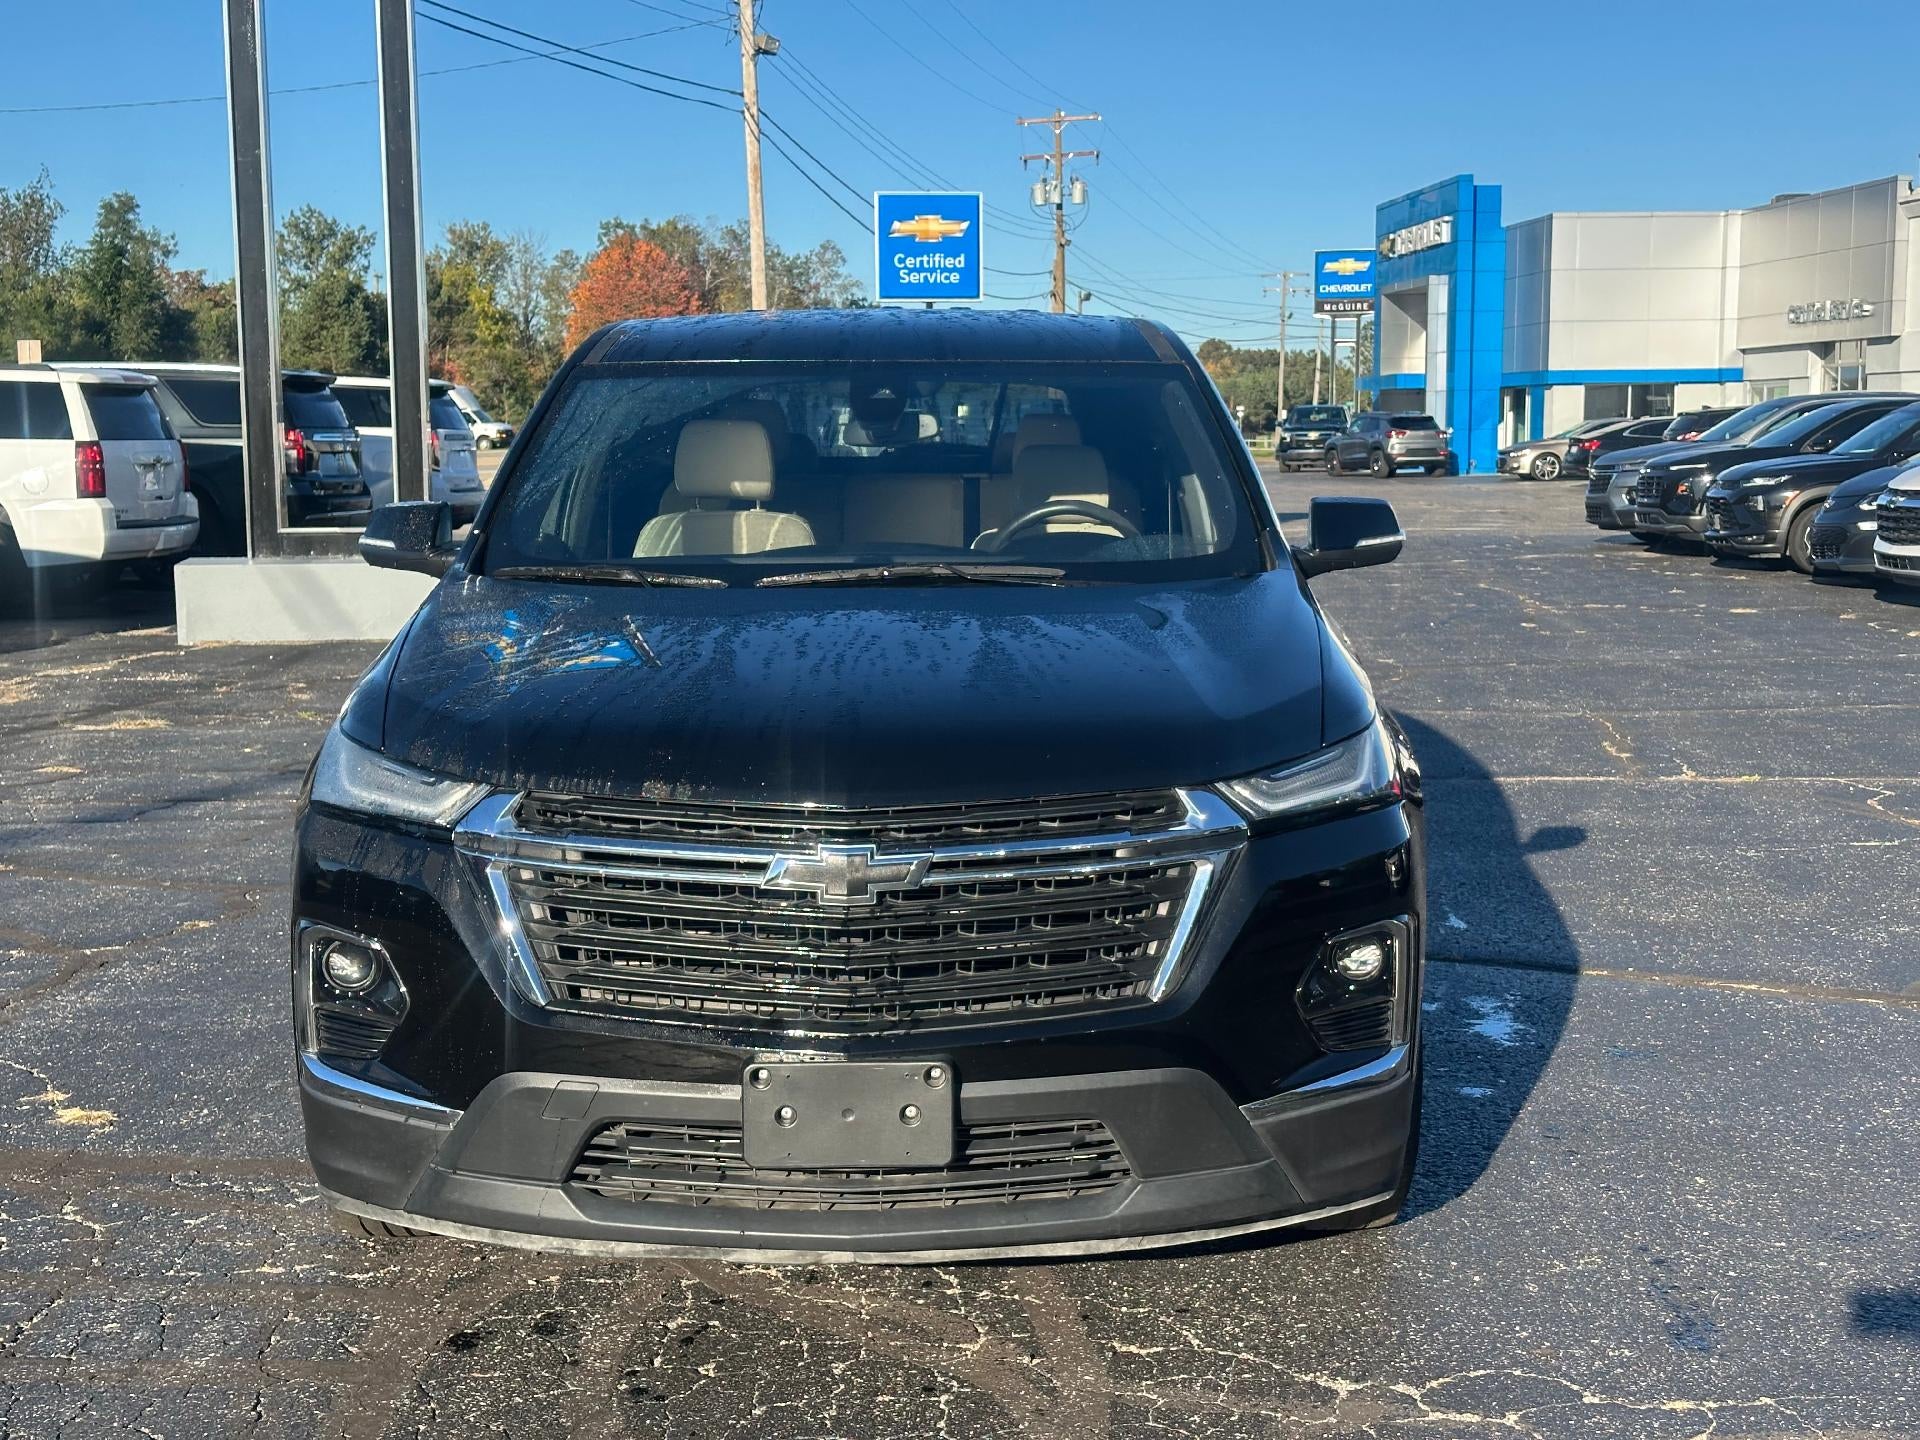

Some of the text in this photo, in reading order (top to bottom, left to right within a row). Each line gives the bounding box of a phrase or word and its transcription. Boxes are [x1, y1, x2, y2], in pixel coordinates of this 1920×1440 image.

[893, 253, 965, 268] Certified
[899, 269, 960, 284] Service
[1319, 283, 1373, 293] CHEVROLET
[1323, 302, 1369, 311] McGUIRE
